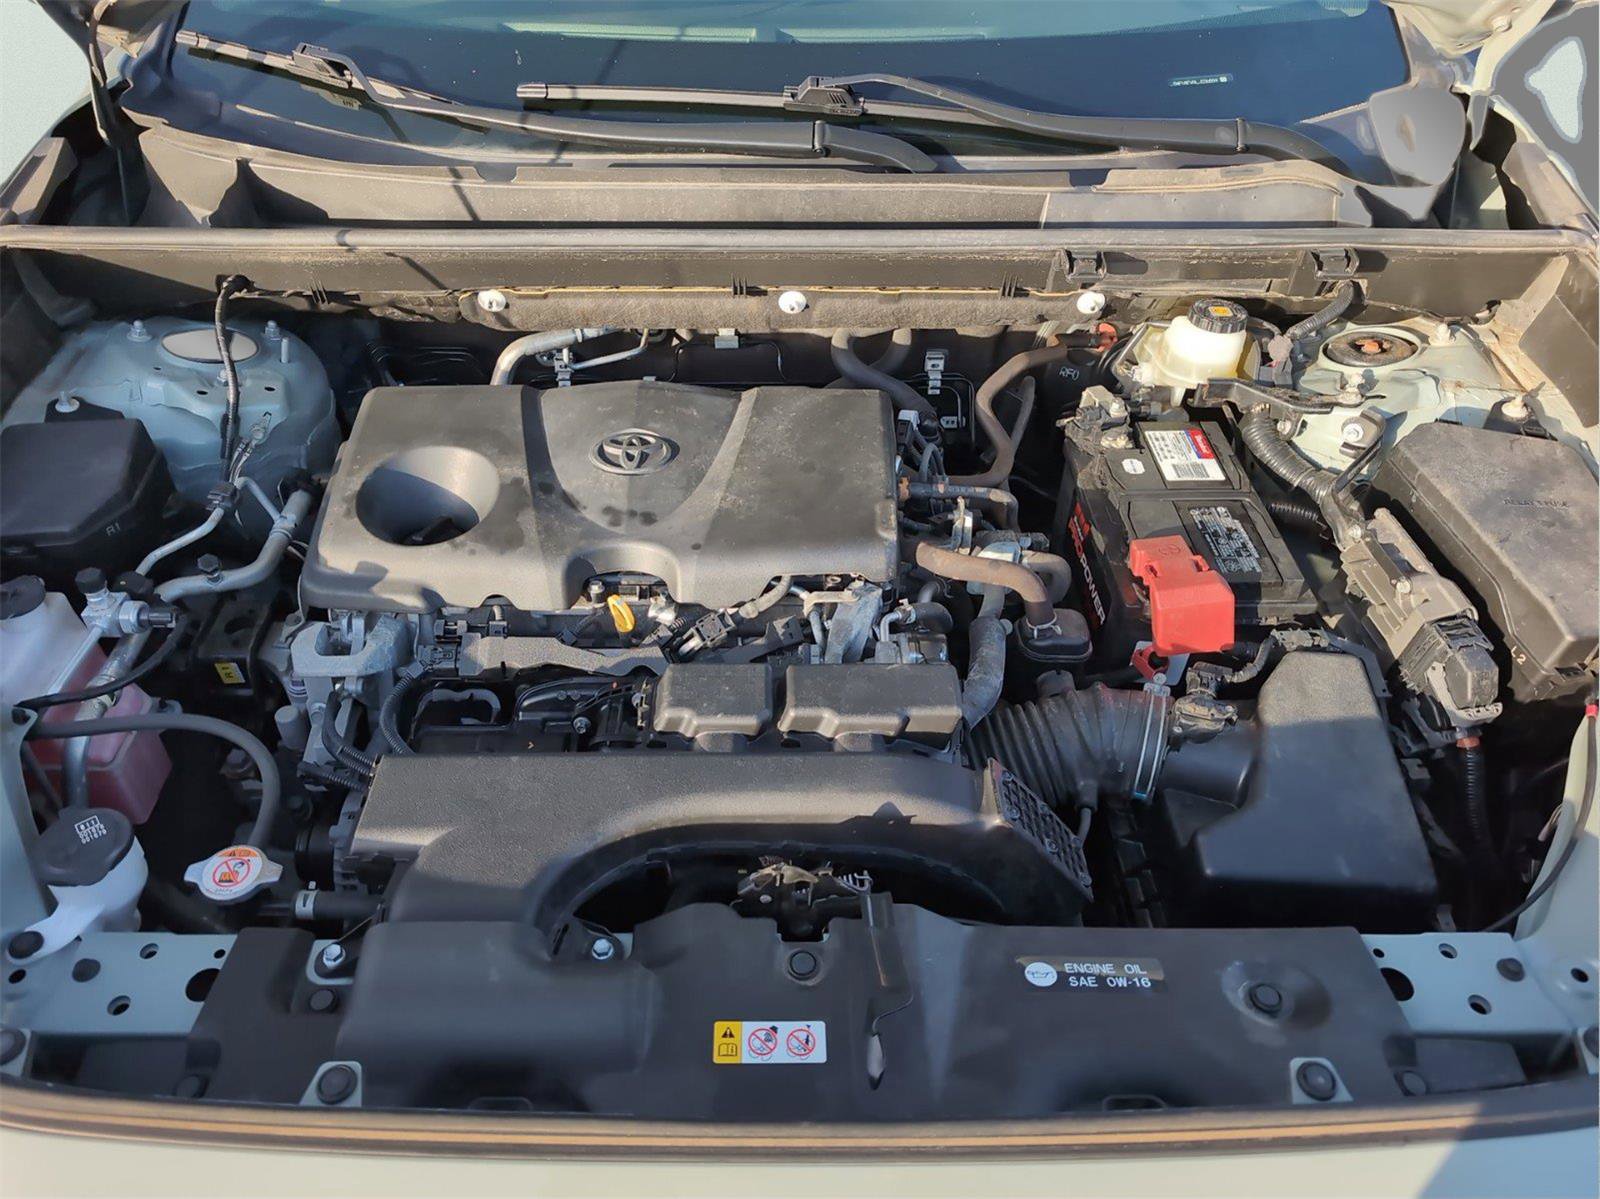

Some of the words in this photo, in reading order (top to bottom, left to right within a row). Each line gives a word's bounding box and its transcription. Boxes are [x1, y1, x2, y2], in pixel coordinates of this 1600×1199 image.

[1063, 962, 1116, 974] ENGINE
[1124, 963, 1147, 975] OIL
[1068, 976, 1098, 988] SAE
[1107, 977, 1152, 988] 0W-16
